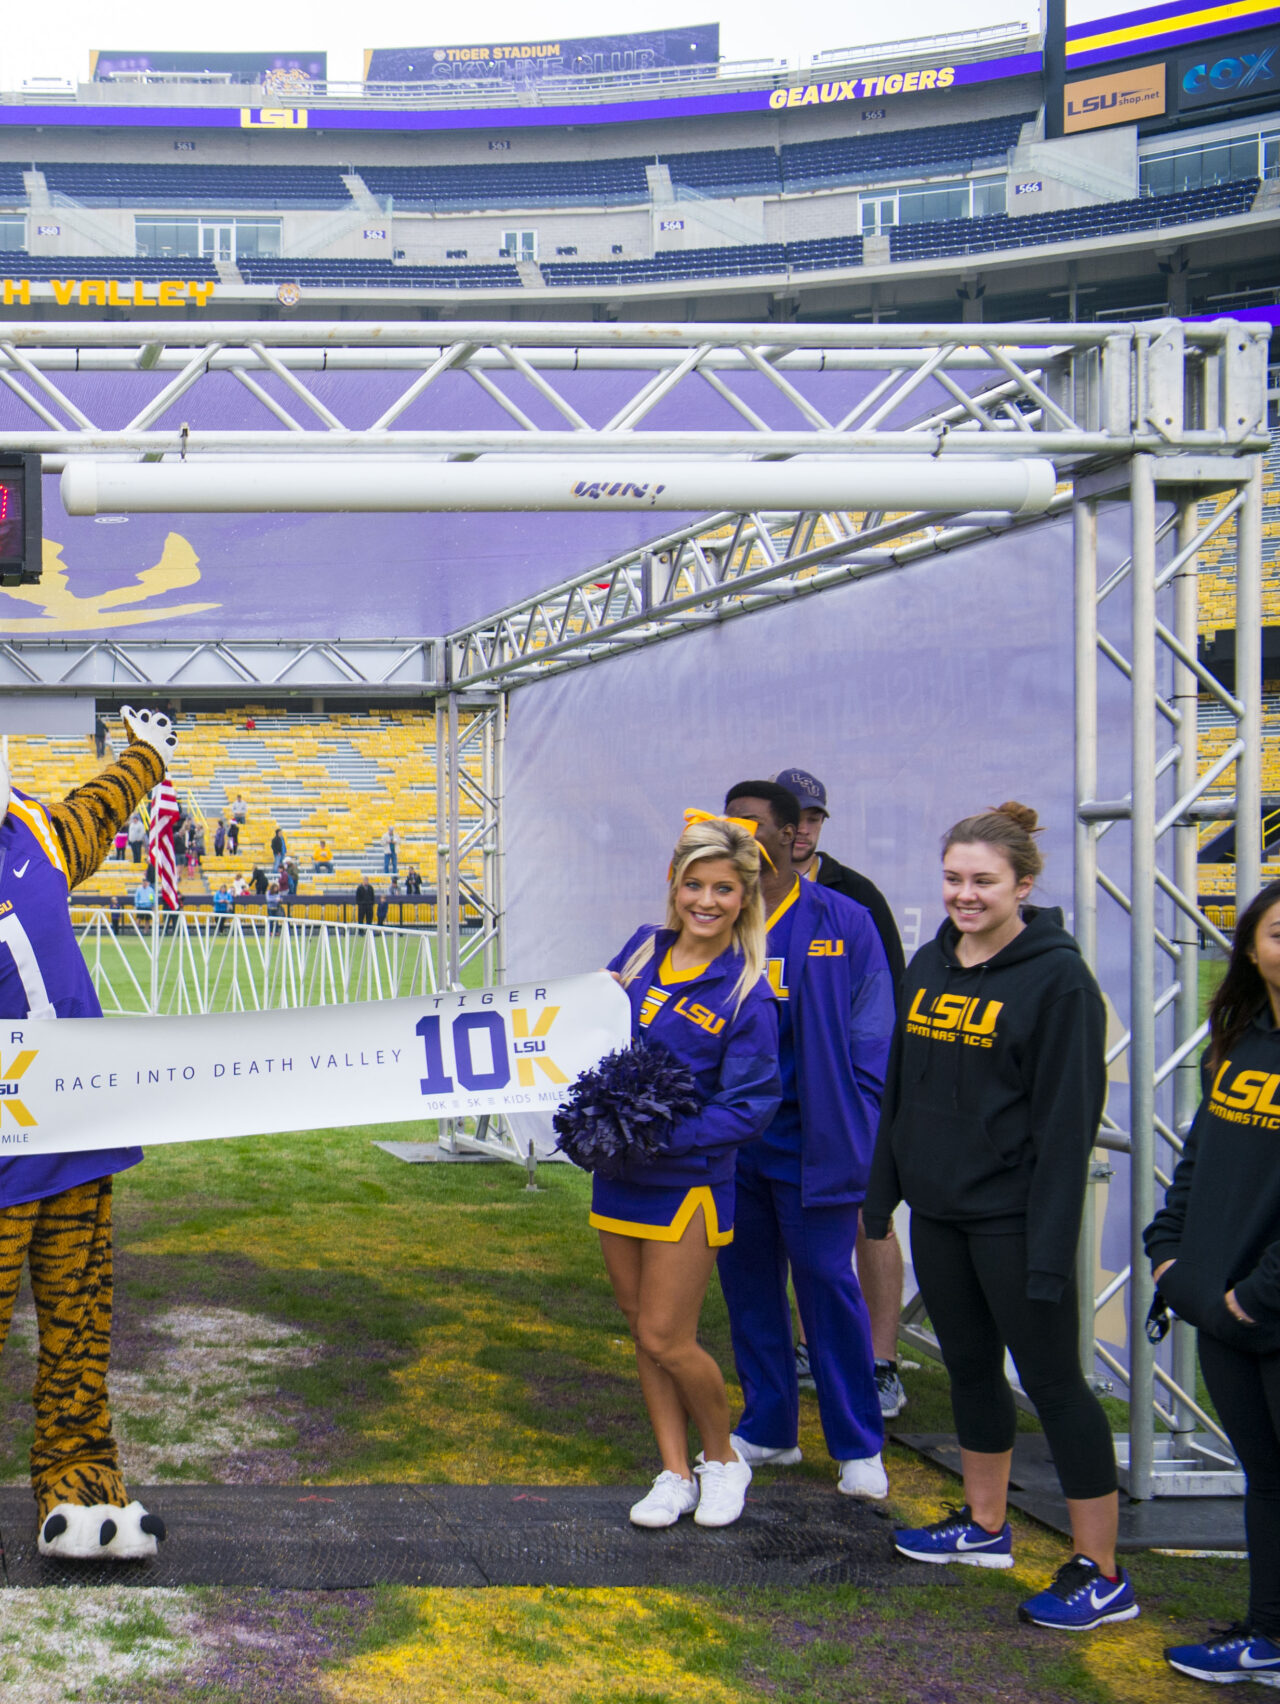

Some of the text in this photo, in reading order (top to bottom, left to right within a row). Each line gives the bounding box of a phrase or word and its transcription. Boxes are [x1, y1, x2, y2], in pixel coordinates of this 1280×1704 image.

[446, 44, 560, 61] TIGER STADIUM
[431, 49, 655, 86] SKYLINE CLUB
[769, 67, 956, 110] GEAUX TIGERS
[1067, 92, 1118, 117] LSU
[240, 108, 308, 129] LSU
[864, 111, 883, 120] 565
[176, 142, 193, 151] 561
[1019, 182, 1039, 193] 566
[40, 226, 58, 236] 560
[366, 230, 384, 239] 562
[663, 221, 681, 231] 564
[50, 279, 215, 307] VALLEY
[792, 773, 820, 797] LSU
[433, 988, 547, 1008] TIGER
[673, 996, 726, 1035] LSU
[907, 987, 1004, 1035] LSU
[906, 1023, 993, 1048] GYMNASICS
[415, 1005, 570, 1096] 10K
[514, 1040, 546, 1053] LSU
[55, 1049, 401, 1092] RACE INTO DEATH VALLEY
[426, 1090, 564, 1111] 10K 5K KIDS MILE
[1, 1133, 29, 1144] MILE
